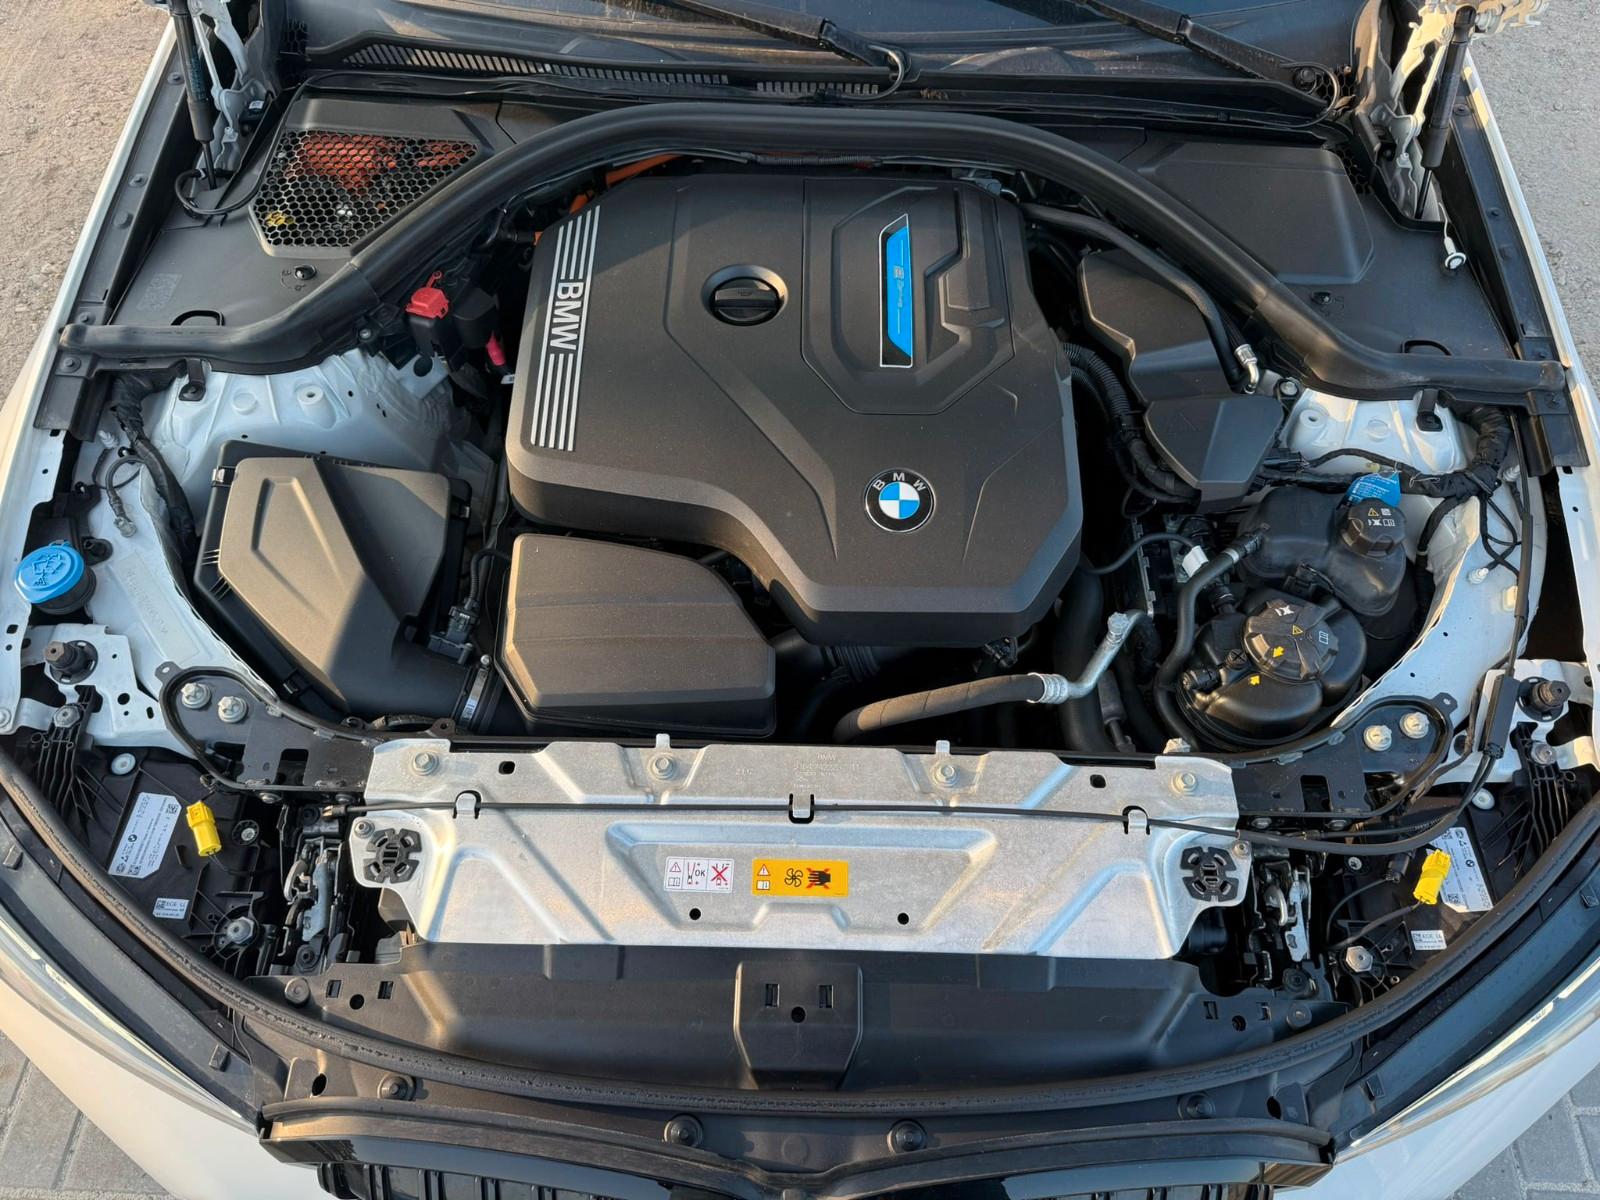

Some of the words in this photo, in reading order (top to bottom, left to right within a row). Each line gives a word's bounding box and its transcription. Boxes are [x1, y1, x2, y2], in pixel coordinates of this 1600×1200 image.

[549, 282, 584, 351] BMW
[873, 472, 926, 491] BMW
[694, 869, 706, 877] OK
